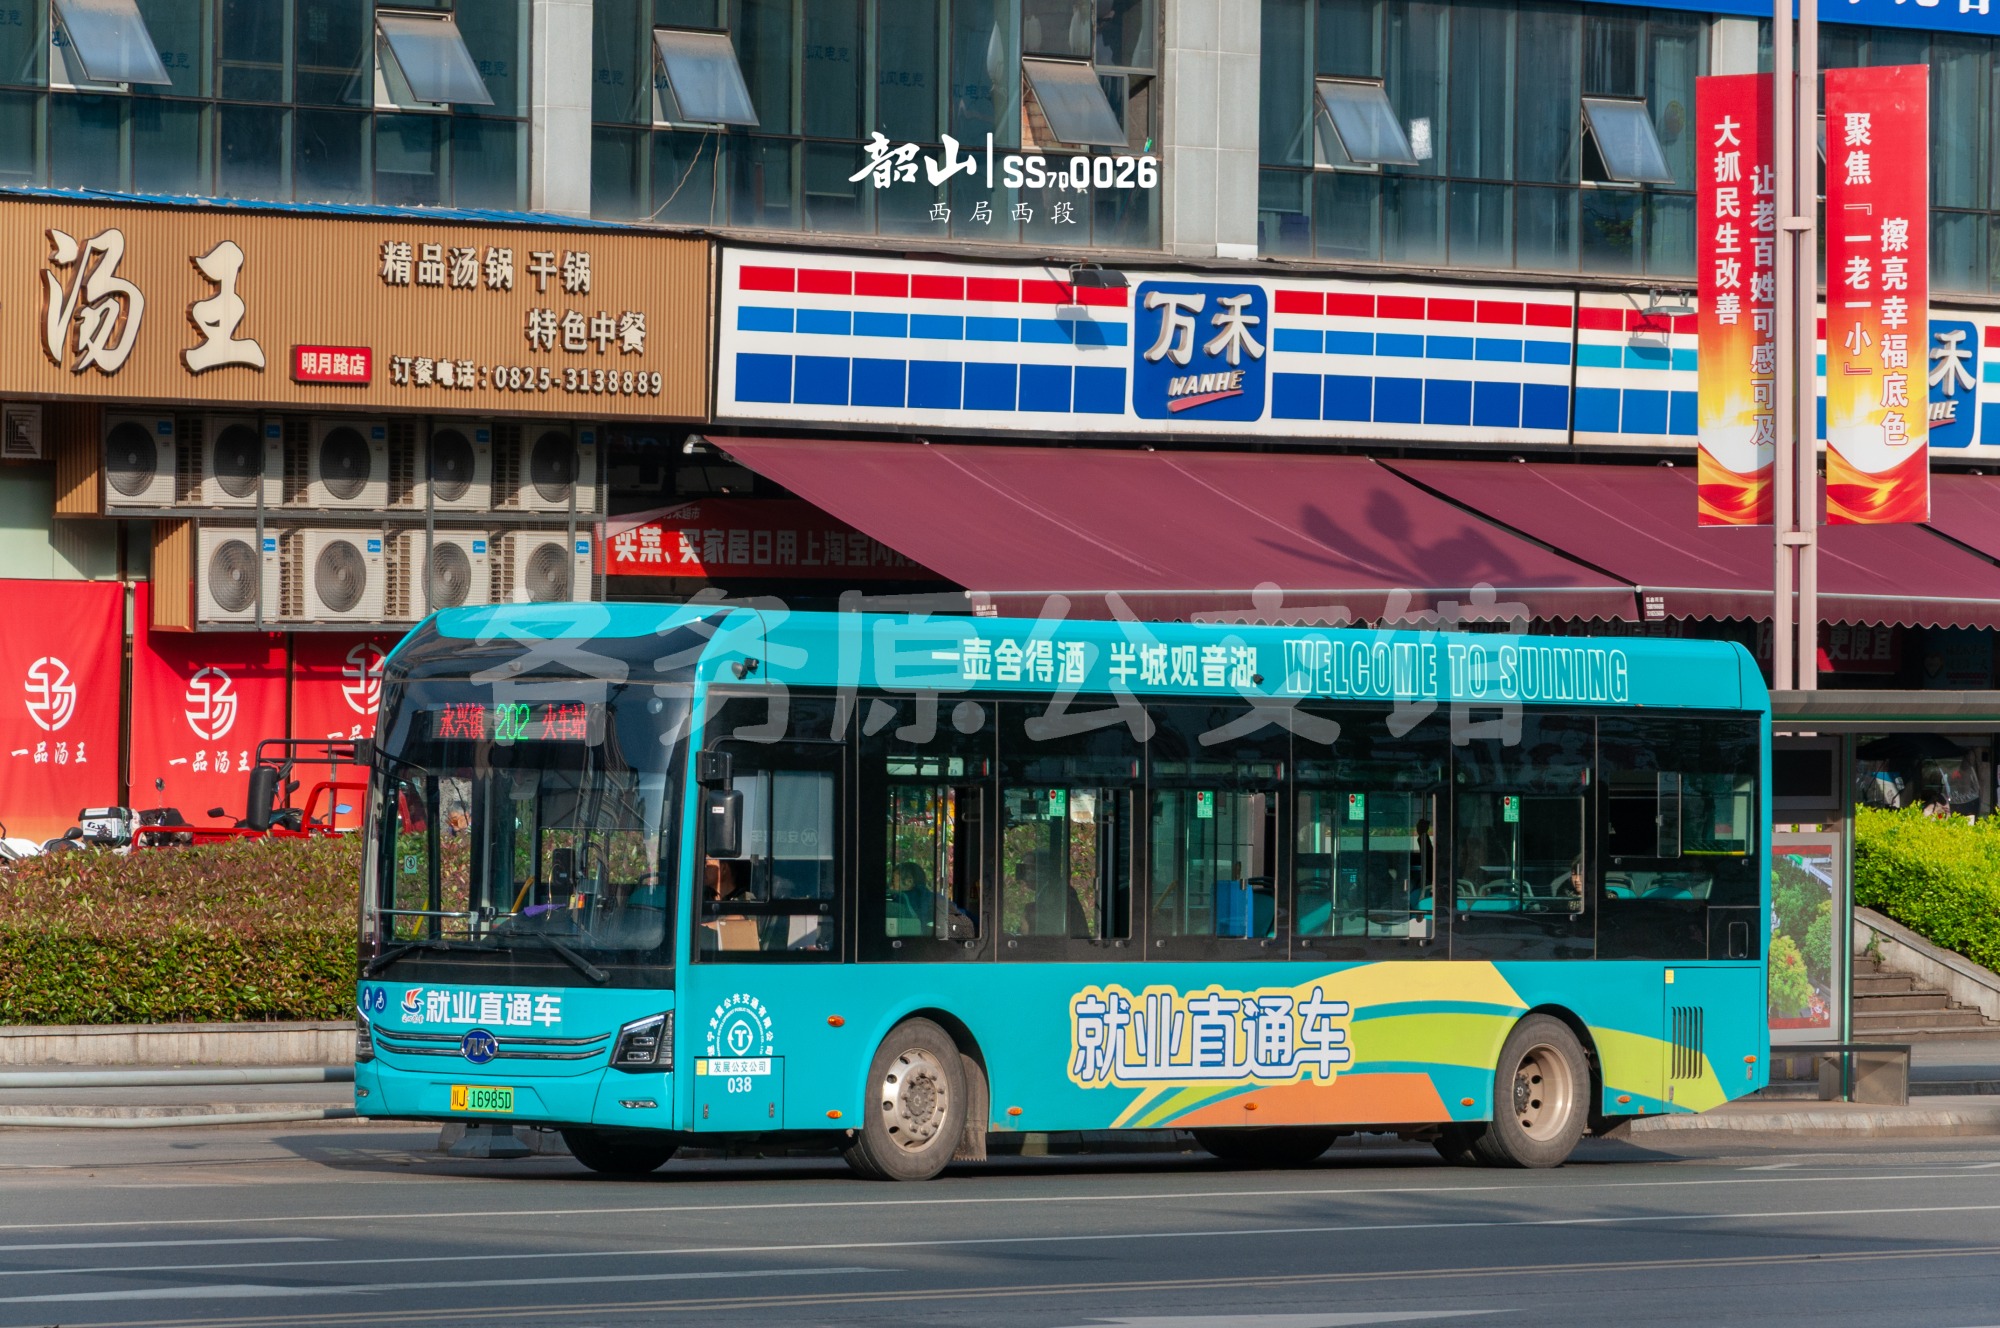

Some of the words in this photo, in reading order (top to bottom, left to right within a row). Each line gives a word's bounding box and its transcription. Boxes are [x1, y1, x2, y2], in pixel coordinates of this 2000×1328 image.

[1713, 115, 1742, 325] 大抓民生改善
[380, 240, 514, 291] 精品汤锅
[528, 250, 592, 295] 干锅
[1749, 164, 1775, 446] 让老百姓可感可及
[527, 308, 647, 355] 特色中餐
[1143, 290, 1266, 366] 万禾
[1880, 217, 1910, 447] 擦亮幸福底色
[301, 351, 366, 377] 明月路店
[1168, 370, 1246, 397] WANHE
[614, 526, 922, 568] 买菜、买家居日用上淘宝闪
[931, 637, 1085, 683] 一壶舍得酒
[1109, 642, 1258, 687] 半城观音湖
[1284, 639, 1438, 696] WELCOME
[1448, 644, 1488, 698] TO
[1499, 645, 1629, 703] SUINING
[495, 703, 530, 740] 202
[541, 703, 587, 740] 火车站
[11, 741, 88, 765] 一品汤王
[169, 750, 251, 774] 一品汤王
[426, 989, 562, 1027] 就业直通车
[1073, 986, 1351, 1081] 就业直通车
[713, 1061, 766, 1073] 发展公交公司
[727, 1077, 752, 1093] 038
